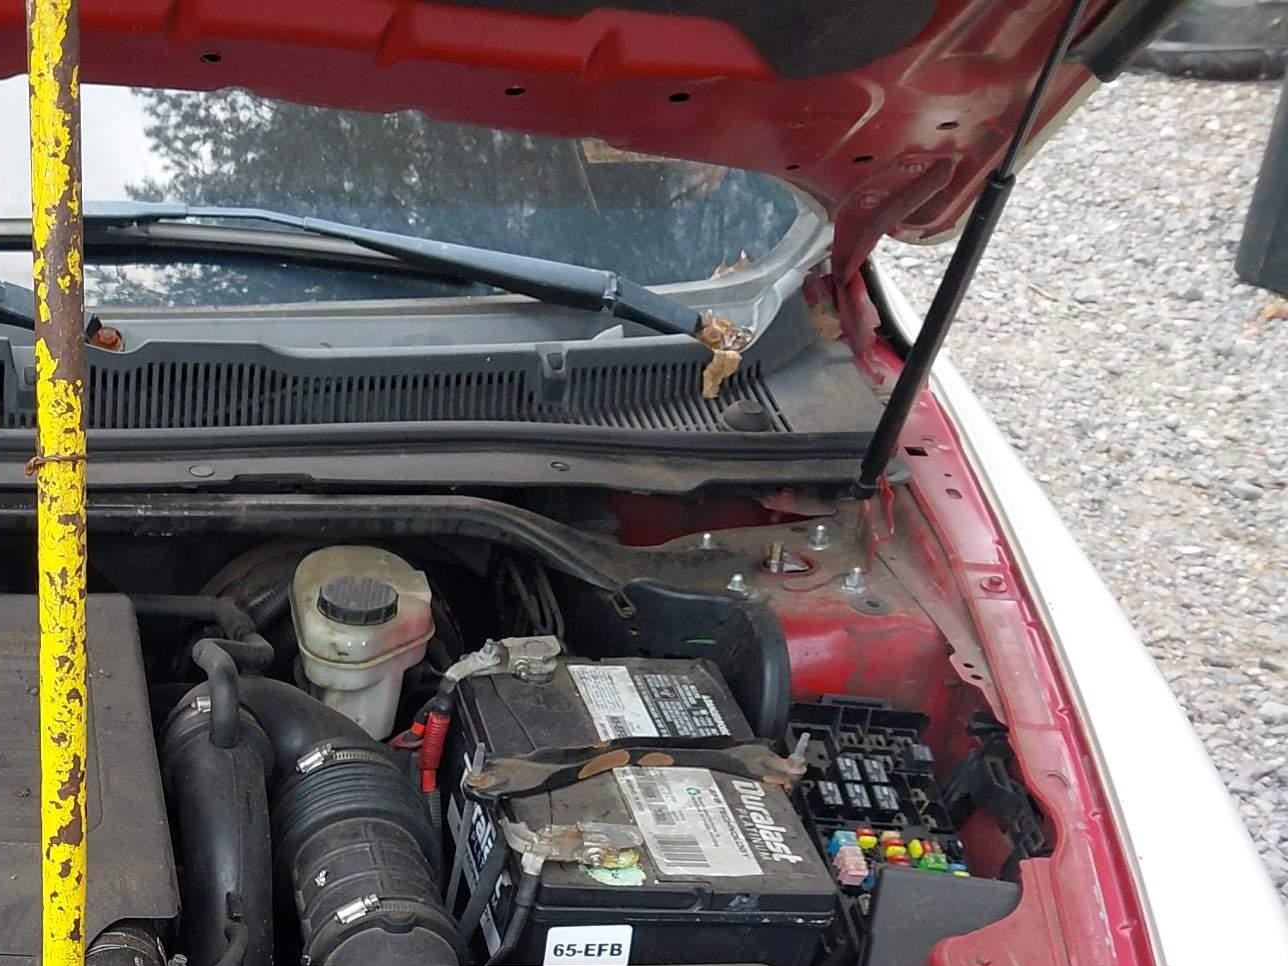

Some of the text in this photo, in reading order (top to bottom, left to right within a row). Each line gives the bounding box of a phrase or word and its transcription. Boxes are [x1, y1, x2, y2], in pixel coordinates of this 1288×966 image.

[731, 779, 803, 864] Duralast
[735, 806, 772, 861] PLATINUM
[553, 943, 623, 957] 65-EFB
